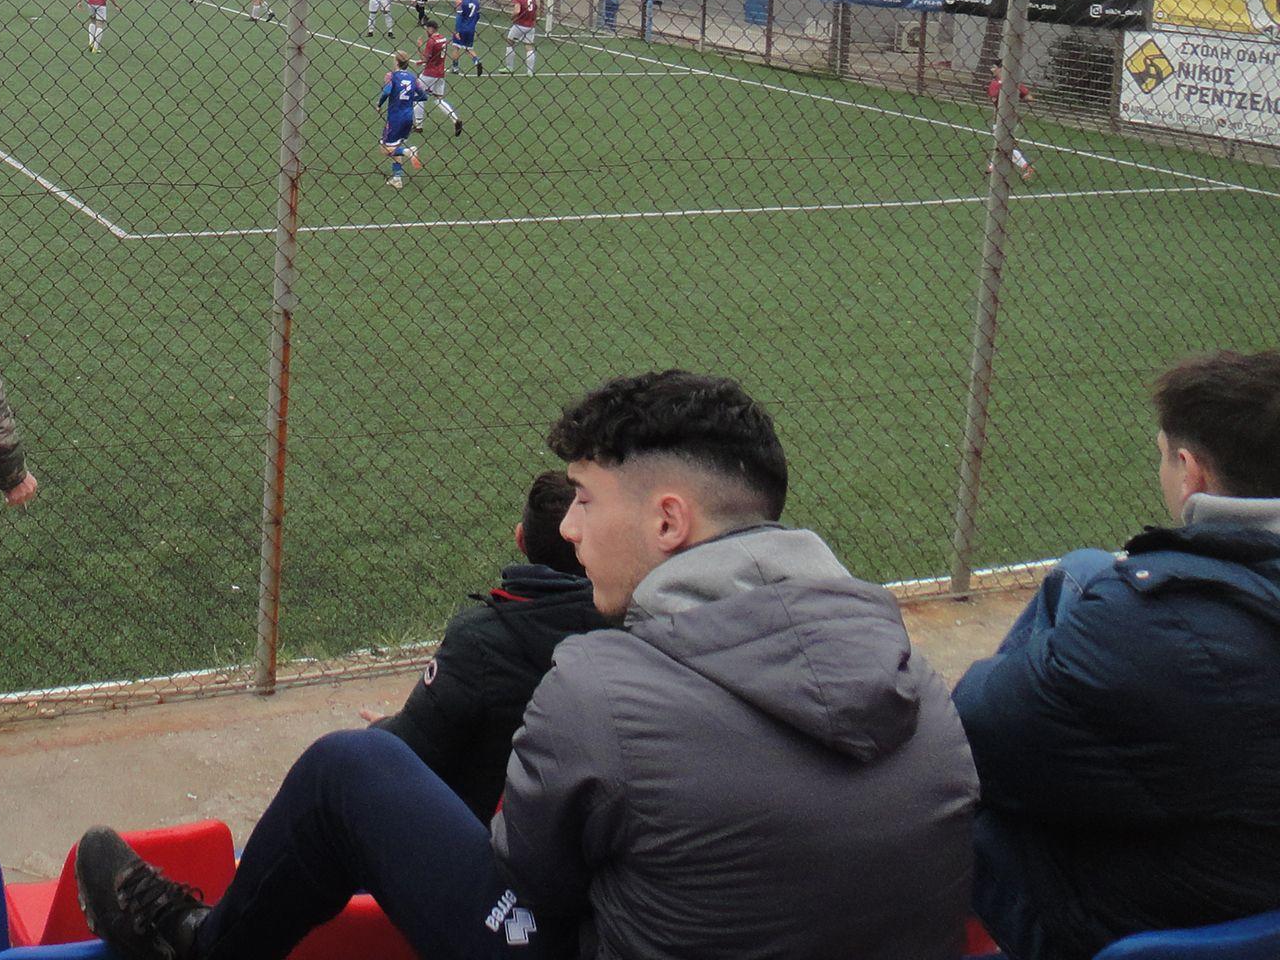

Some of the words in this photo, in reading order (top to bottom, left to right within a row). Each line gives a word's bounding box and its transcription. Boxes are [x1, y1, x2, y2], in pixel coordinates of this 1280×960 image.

[468, 3, 476, 17] 7
[1180, 42, 1231, 60] ΣΧΟΛΗ
[1177, 62, 1234, 85] ΝΙΚΟΣ
[399, 79, 411, 100] 2
